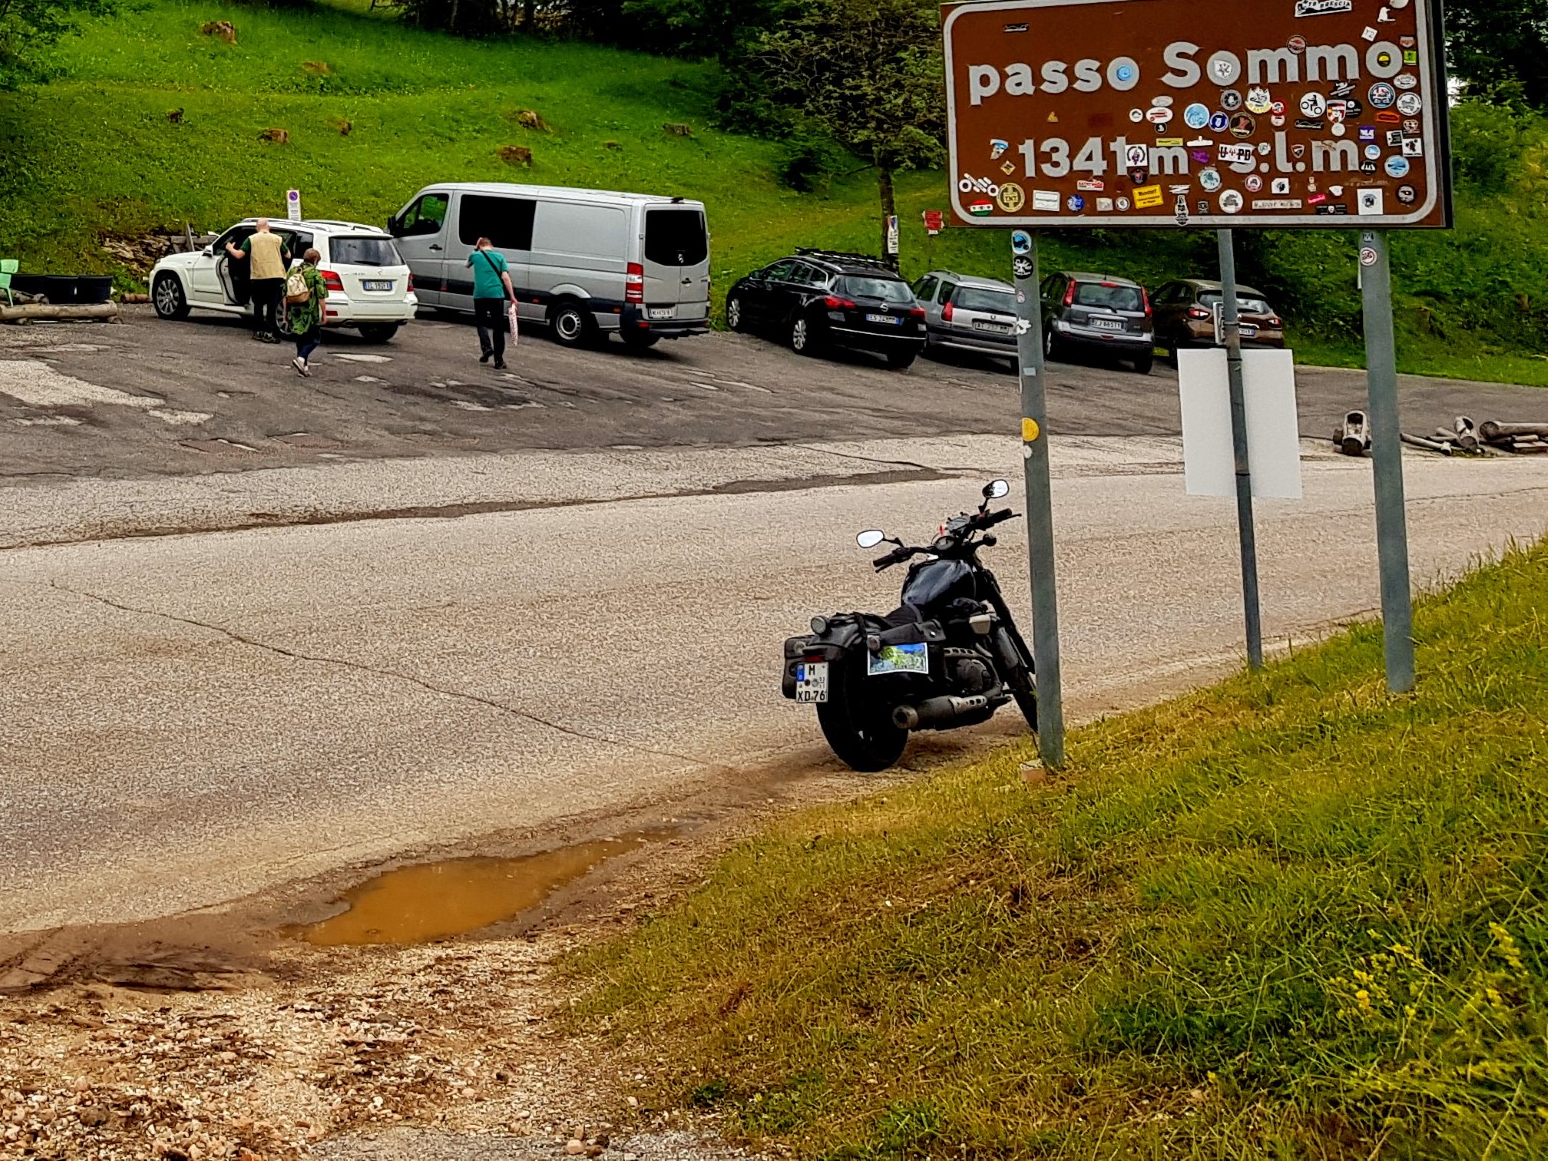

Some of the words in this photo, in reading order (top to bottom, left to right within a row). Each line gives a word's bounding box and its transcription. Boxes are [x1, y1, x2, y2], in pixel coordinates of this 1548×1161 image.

[1320, 0, 1351, 9] BRESCIA
[967, 55, 1140, 106] passo
[1157, 40, 1403, 88] Sommo
[1018, 135, 1128, 178] 1341
[1148, 146, 1190, 176] m
[798, 690, 811, 701] XD
[813, 690, 826, 701] 76
